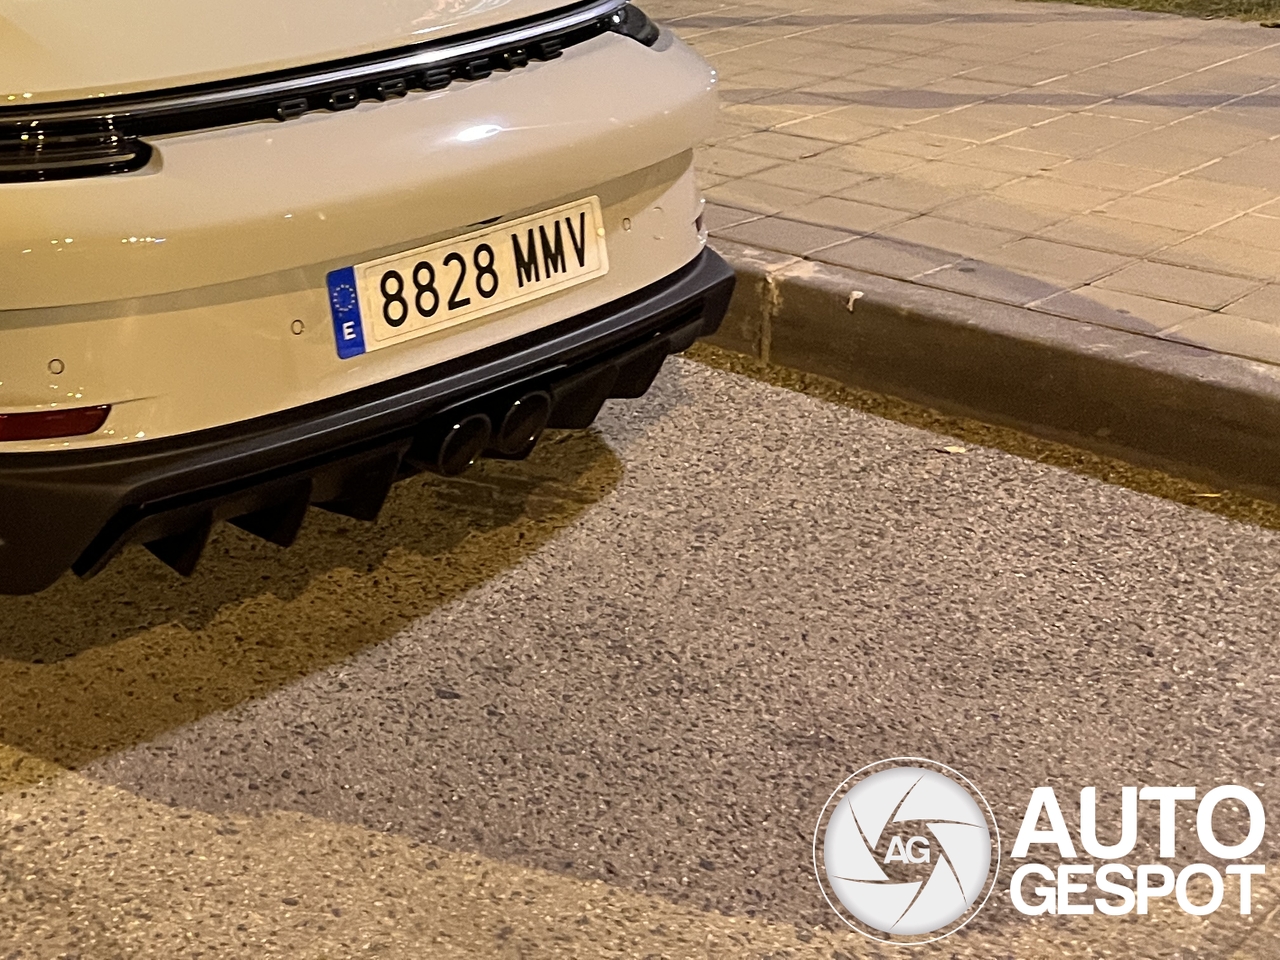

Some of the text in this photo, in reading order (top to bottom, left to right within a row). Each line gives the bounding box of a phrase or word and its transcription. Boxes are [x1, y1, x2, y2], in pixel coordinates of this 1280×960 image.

[379, 211, 586, 328] 8828 MMV
[342, 320, 357, 341] E
